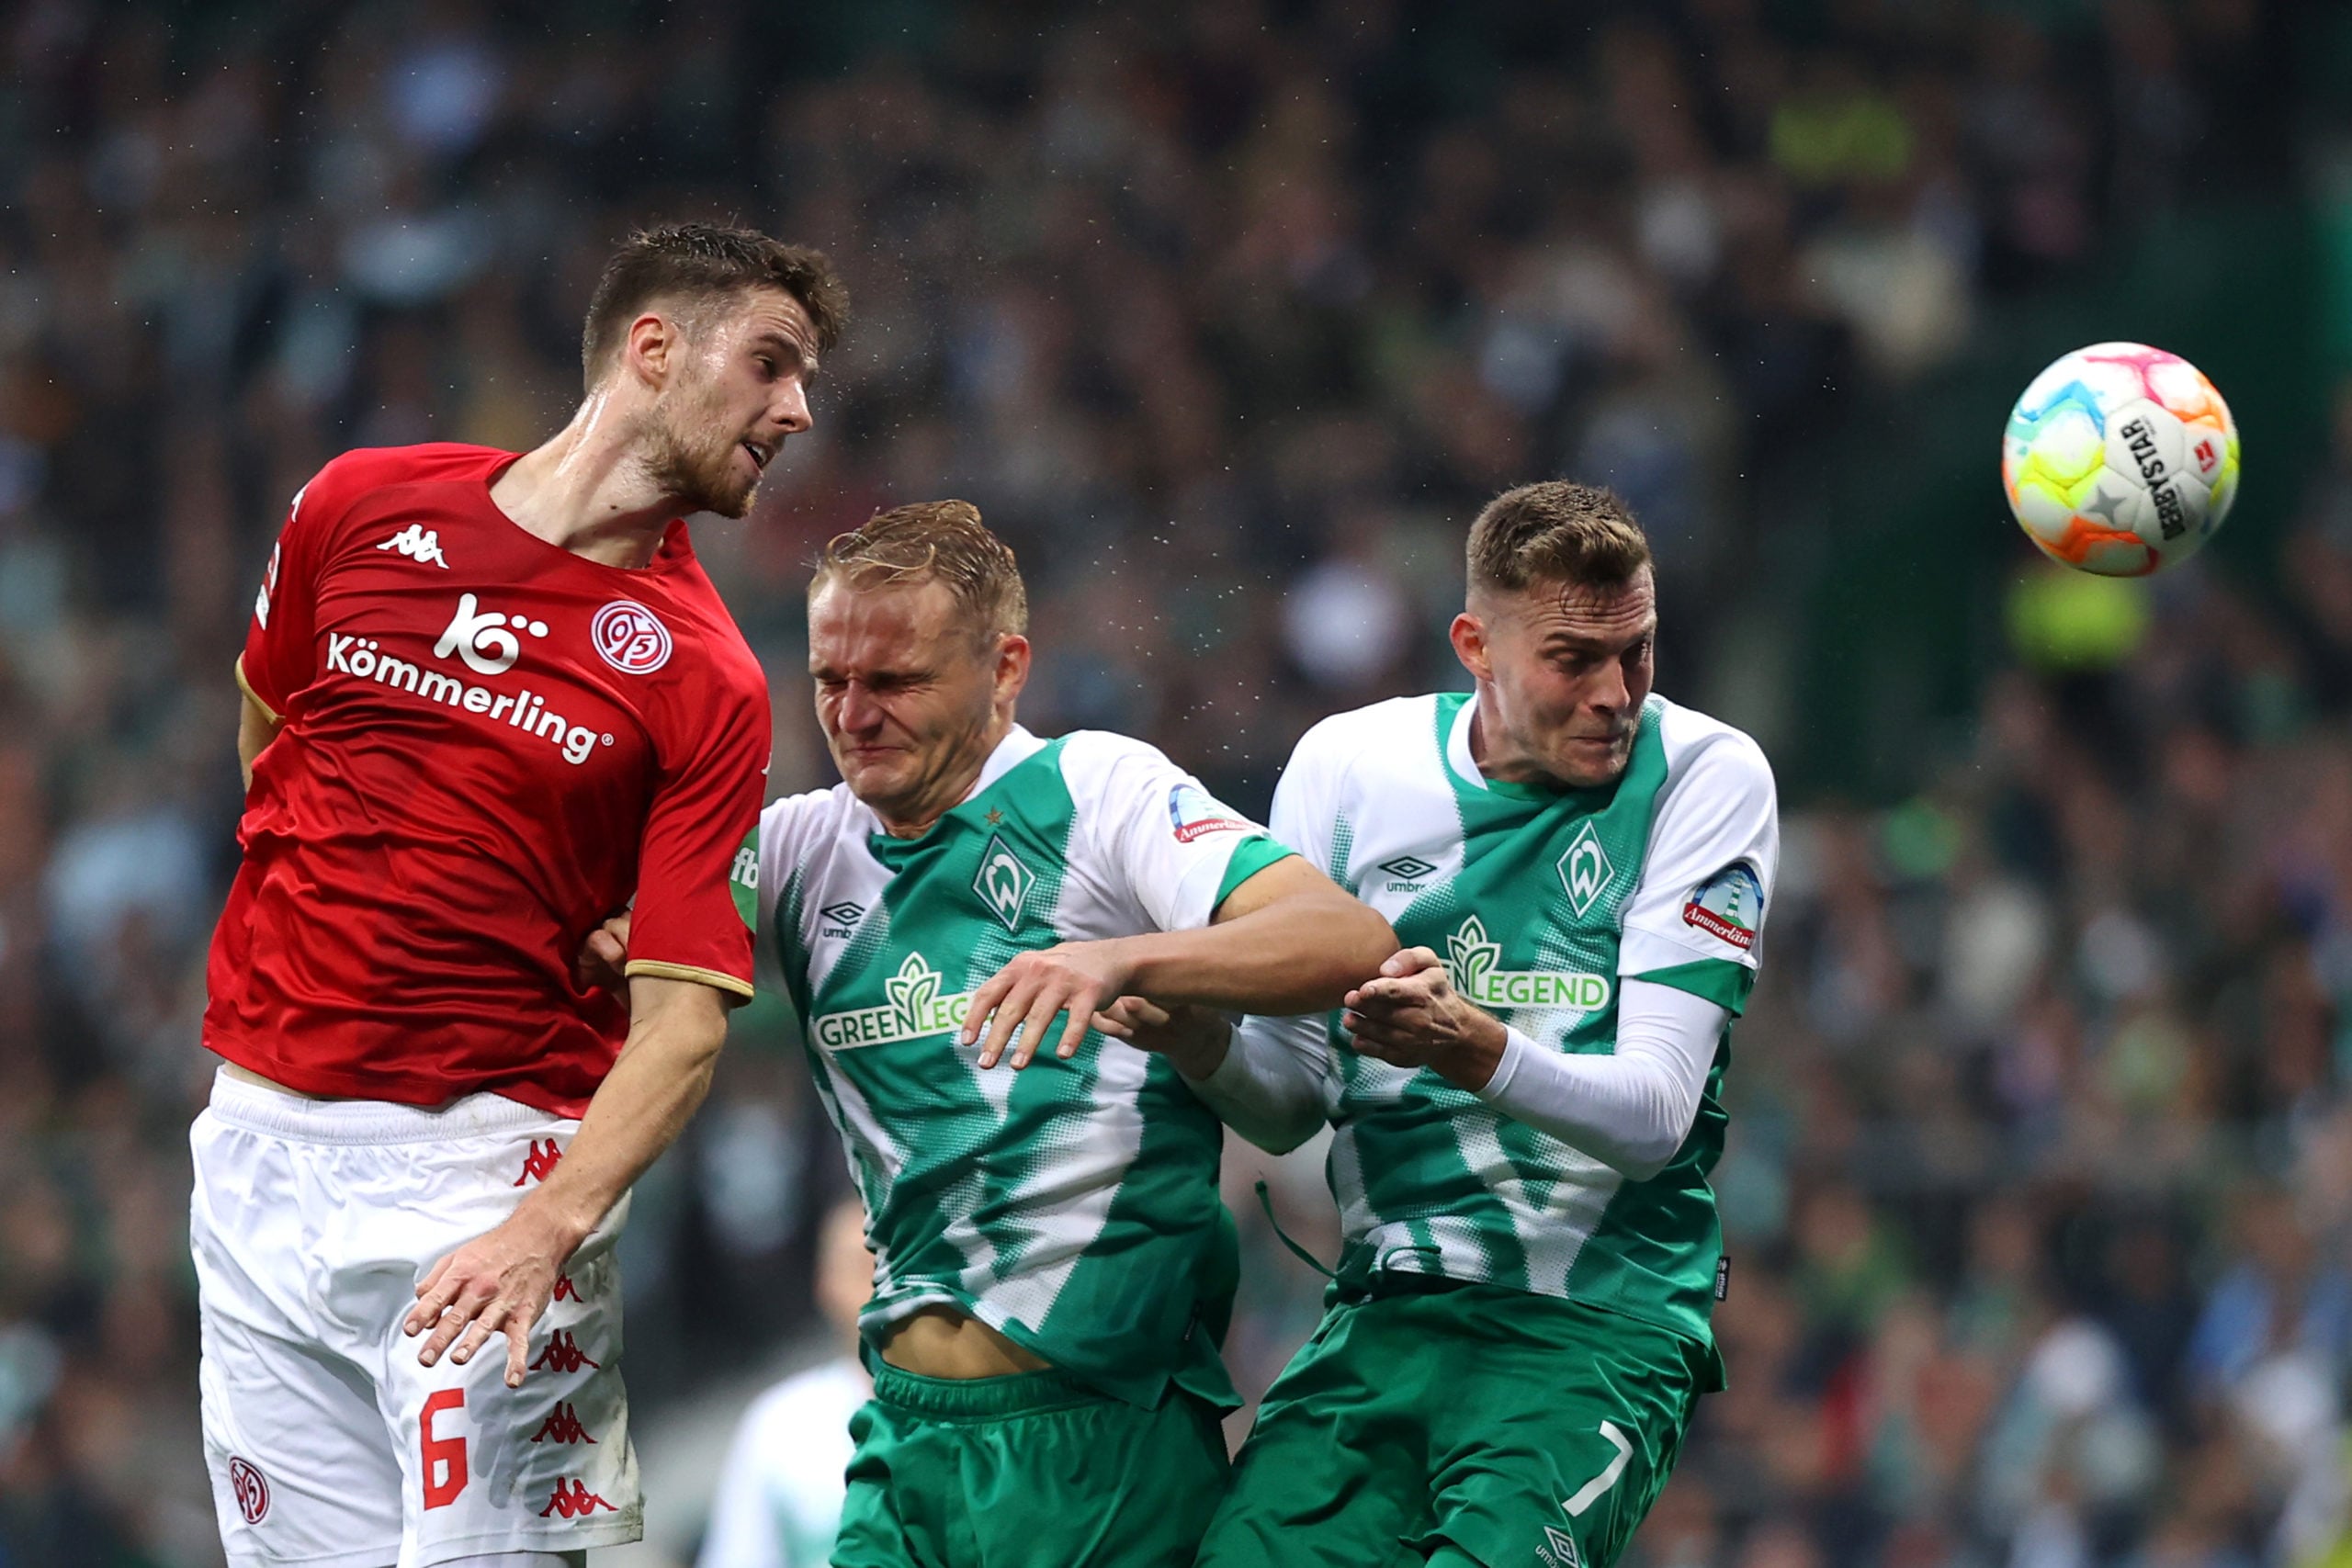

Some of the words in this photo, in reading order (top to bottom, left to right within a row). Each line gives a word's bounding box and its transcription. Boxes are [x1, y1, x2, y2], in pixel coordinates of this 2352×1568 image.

[2120, 418, 2186, 541] DERBYSTAR
[823, 927, 853, 939] umb
[419, 1387, 469, 1511] 6
[1562, 1419, 1634, 1517] 7
[1535, 1544, 1561, 1568] umb
